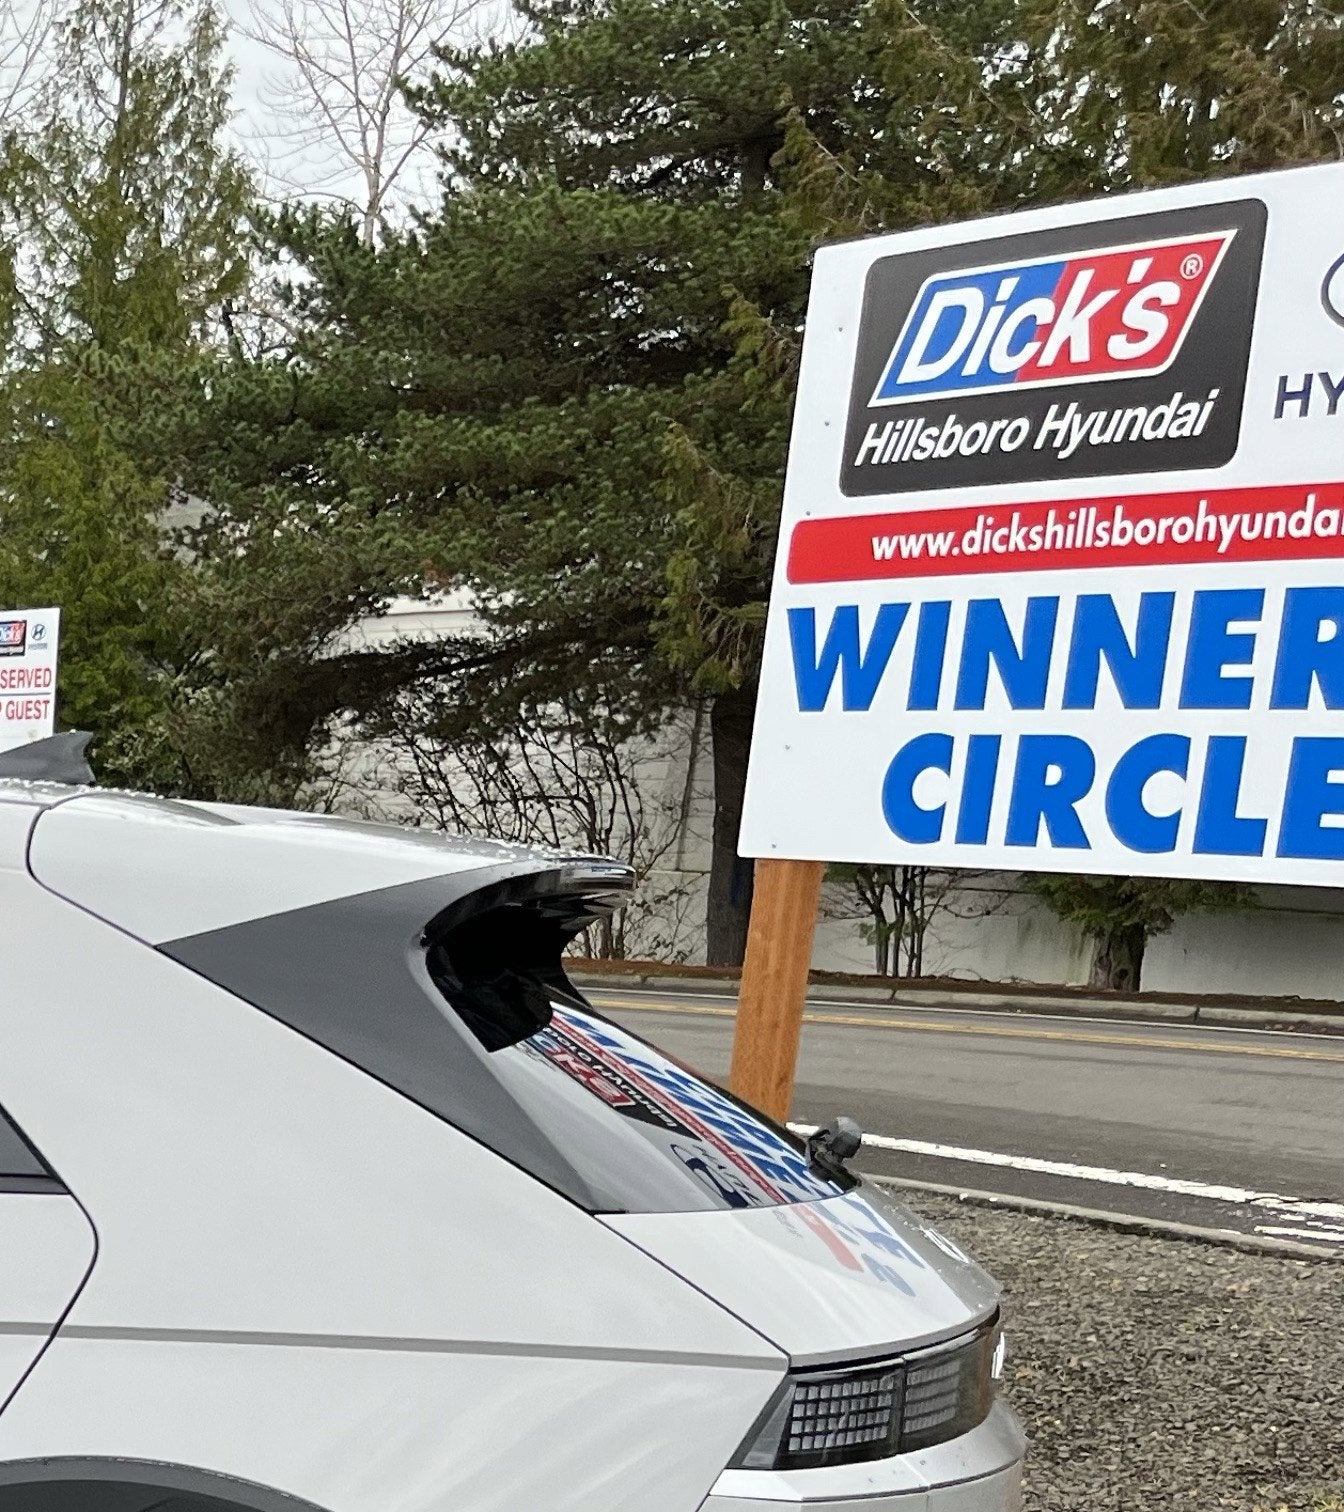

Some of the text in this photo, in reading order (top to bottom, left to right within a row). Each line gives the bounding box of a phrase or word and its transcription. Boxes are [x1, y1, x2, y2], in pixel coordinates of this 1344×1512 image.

[854, 388, 1221, 467] Hillsboro Hyundai
[786, 586, 1344, 713] WINNER
[6, 699, 50, 721] GUEST
[881, 732, 1344, 860] CIRCLE
